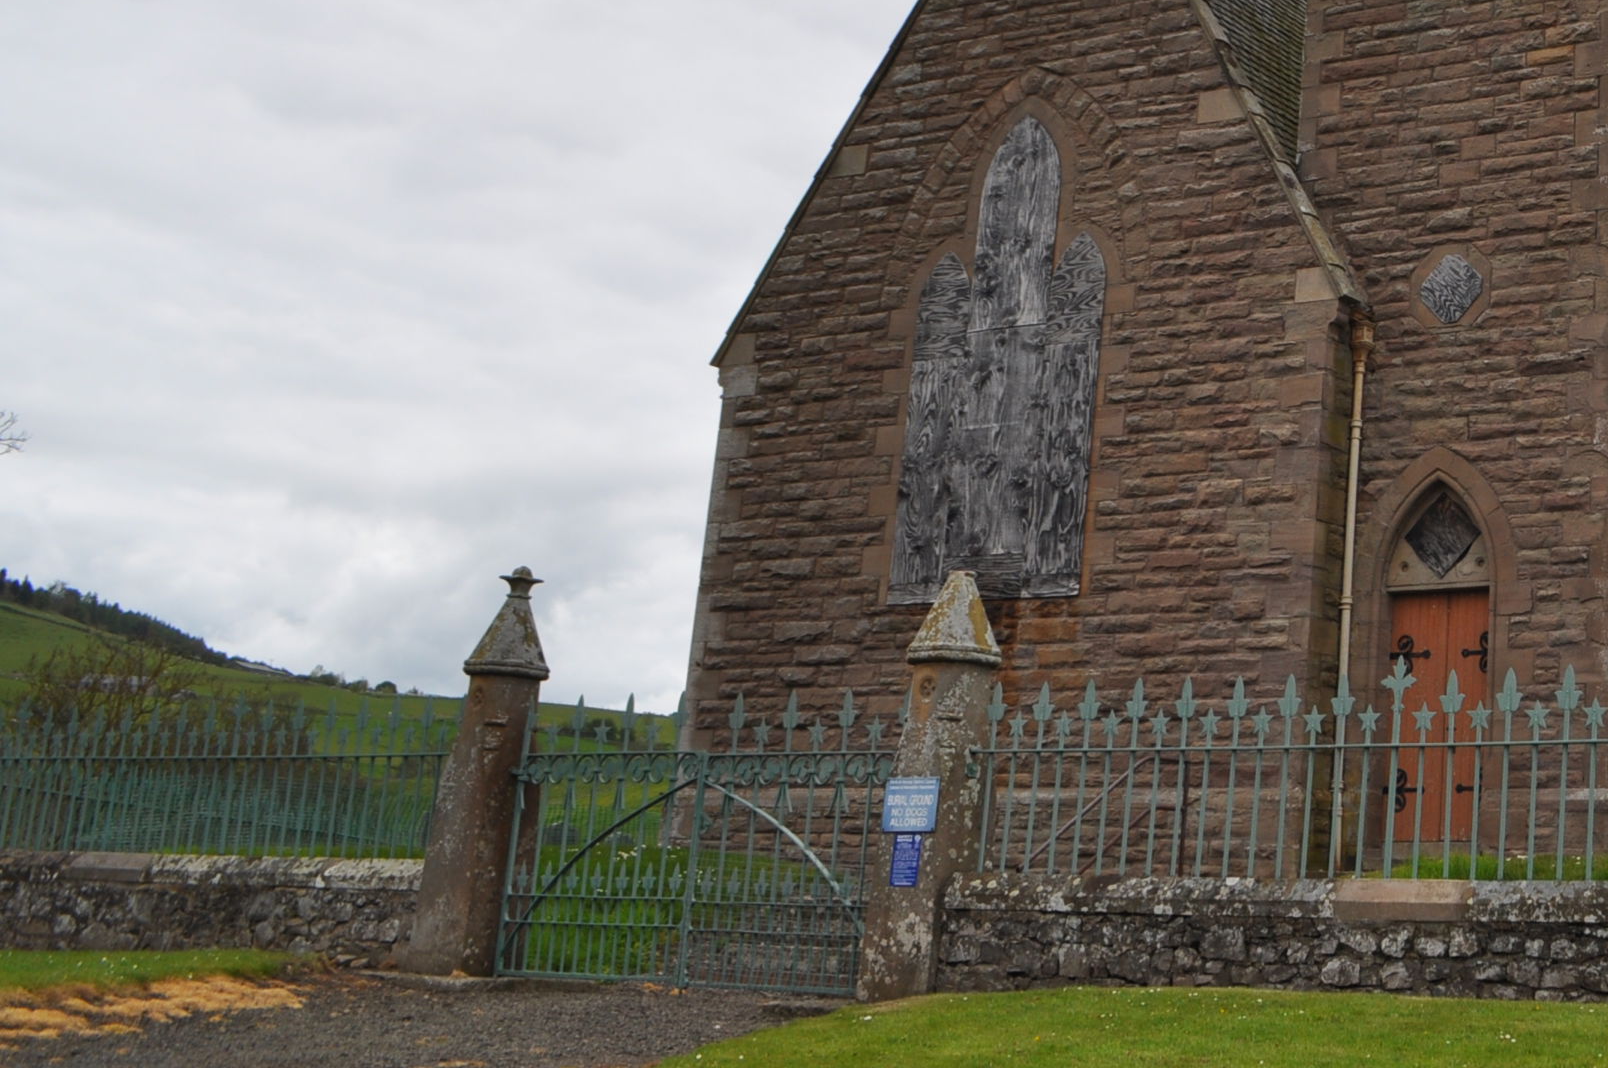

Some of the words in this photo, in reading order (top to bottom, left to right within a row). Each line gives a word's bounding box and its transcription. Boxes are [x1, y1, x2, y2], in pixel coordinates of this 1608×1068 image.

[888, 795, 907, 806] BURIAL
[909, 794, 934, 805] GROUND
[891, 808, 903, 817] NO
[905, 807, 929, 817] DOGS
[889, 817, 928, 827] ALLOWED
